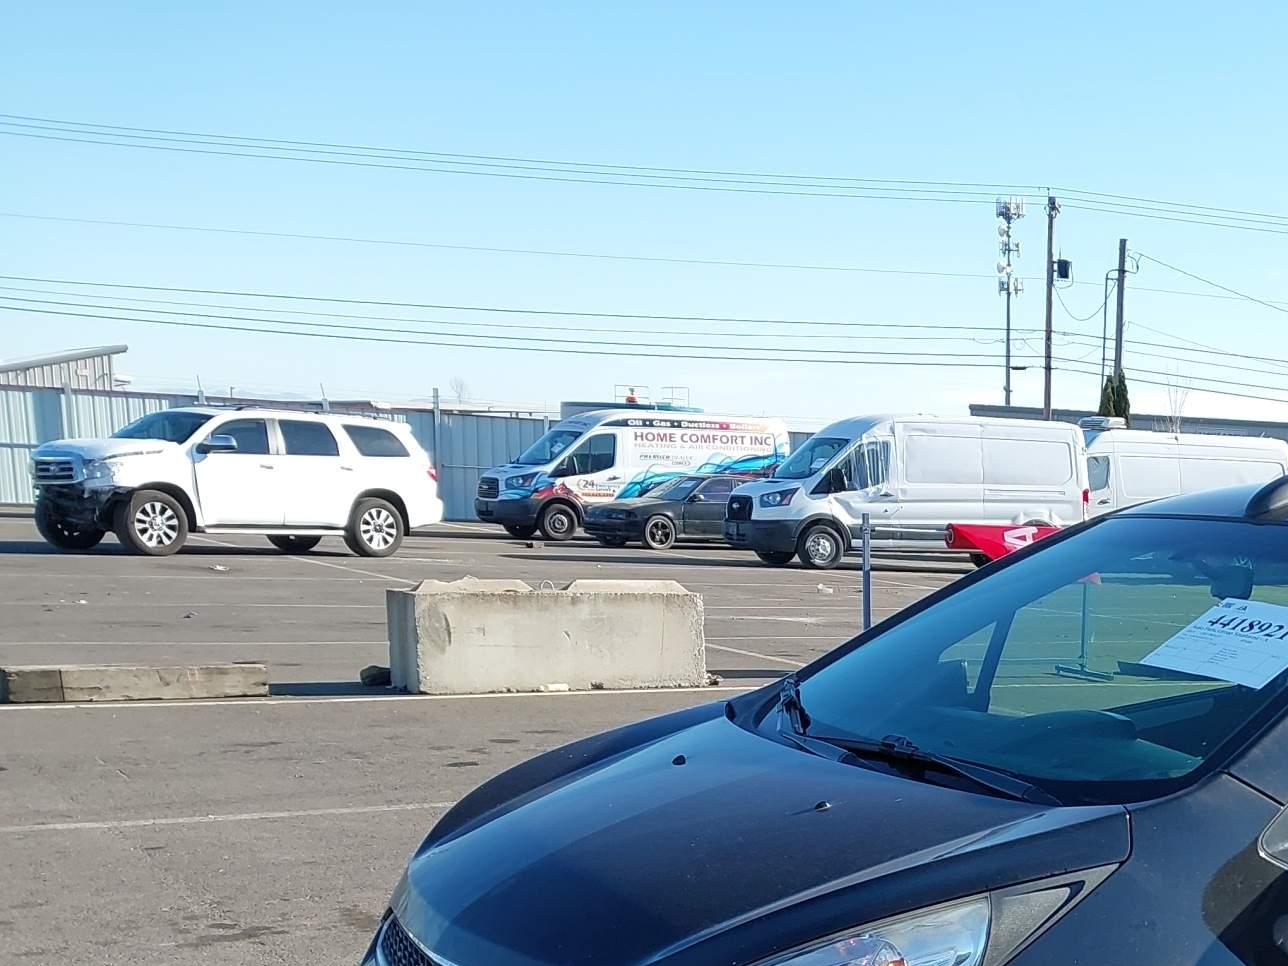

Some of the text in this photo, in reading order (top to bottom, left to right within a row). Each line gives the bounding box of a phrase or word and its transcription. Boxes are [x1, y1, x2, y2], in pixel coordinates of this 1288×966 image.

[680, 421, 721, 429] Ductless
[634, 431, 772, 446] HOME COMFORT INC
[582, 479, 595, 489] 24
